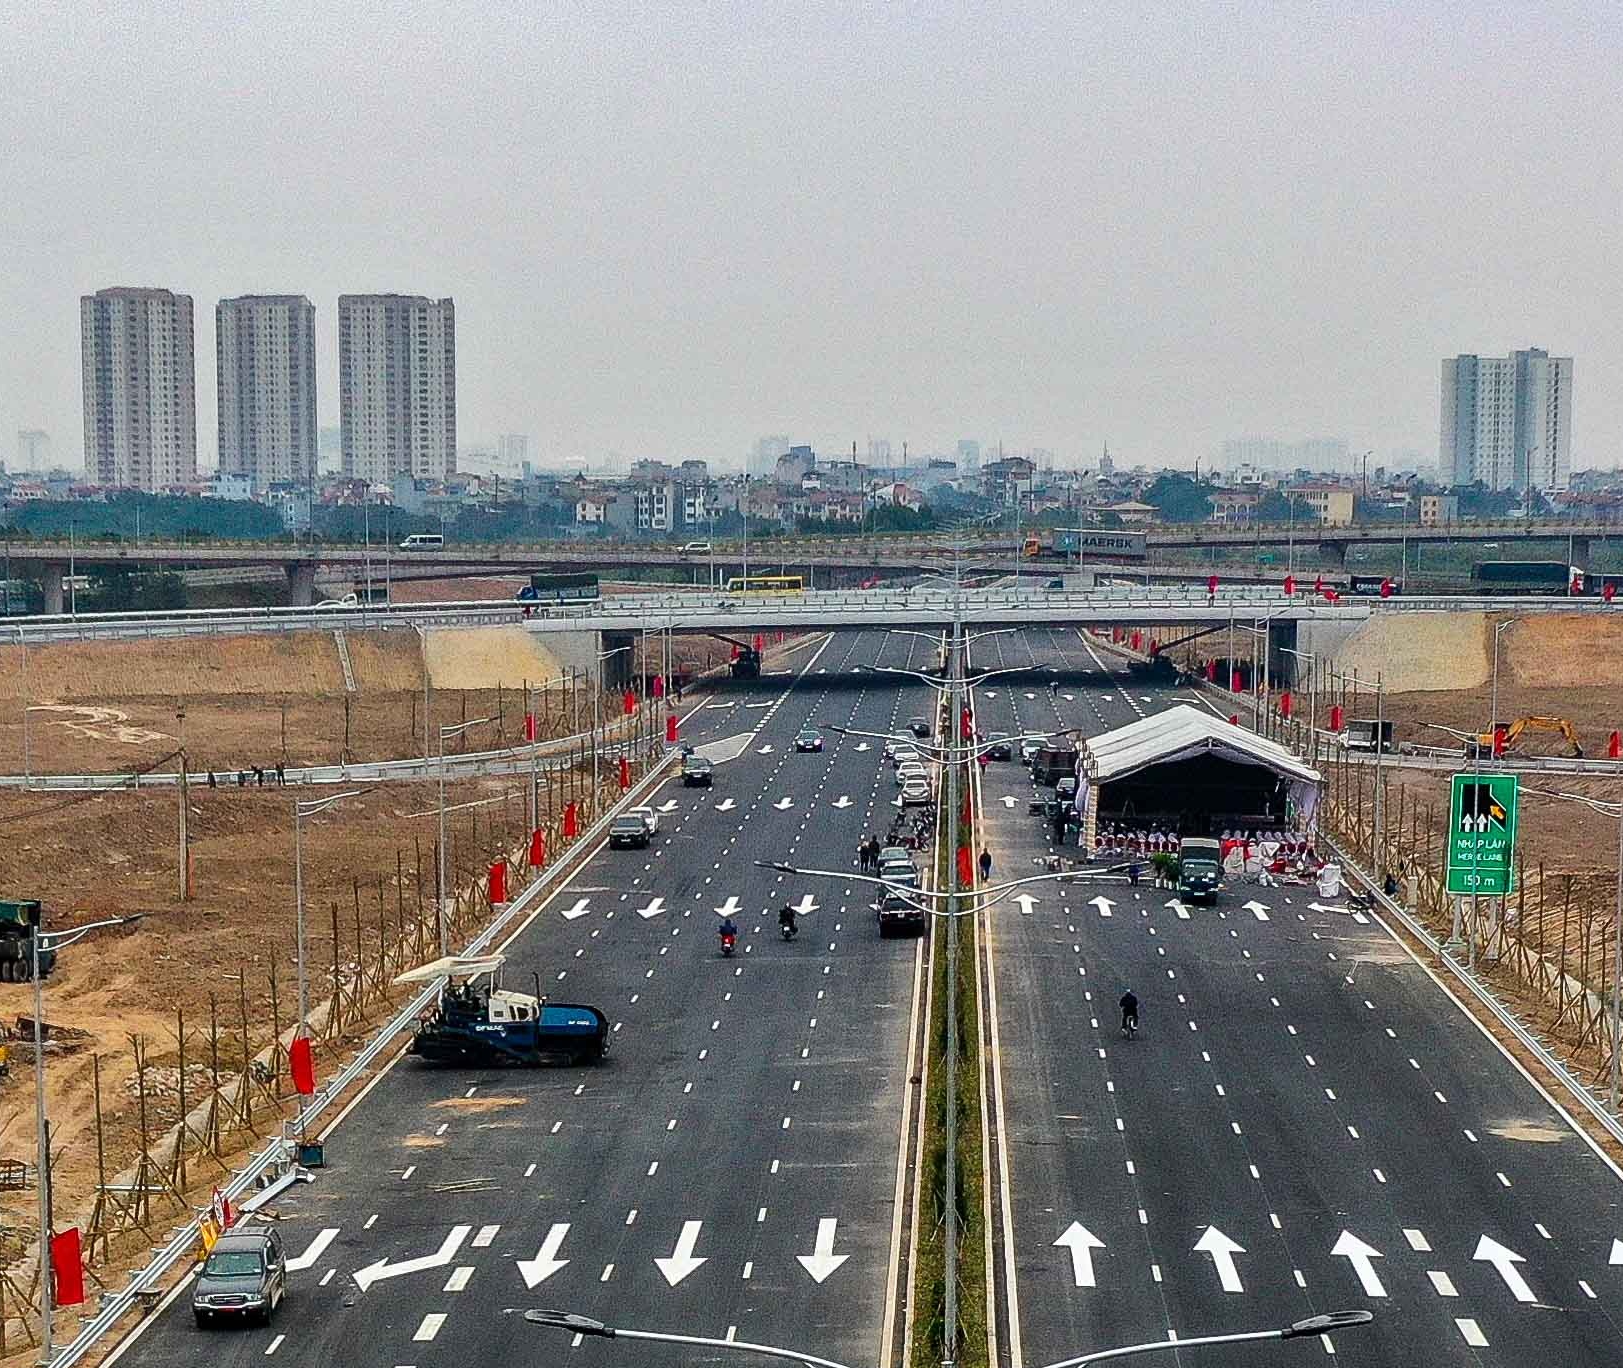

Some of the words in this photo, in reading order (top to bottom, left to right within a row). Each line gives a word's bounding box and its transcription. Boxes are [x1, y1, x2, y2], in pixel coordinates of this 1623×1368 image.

[1078, 537, 1133, 548] MAERSK
[1464, 875, 1481, 886] 150
[1484, 878, 1495, 886] m
